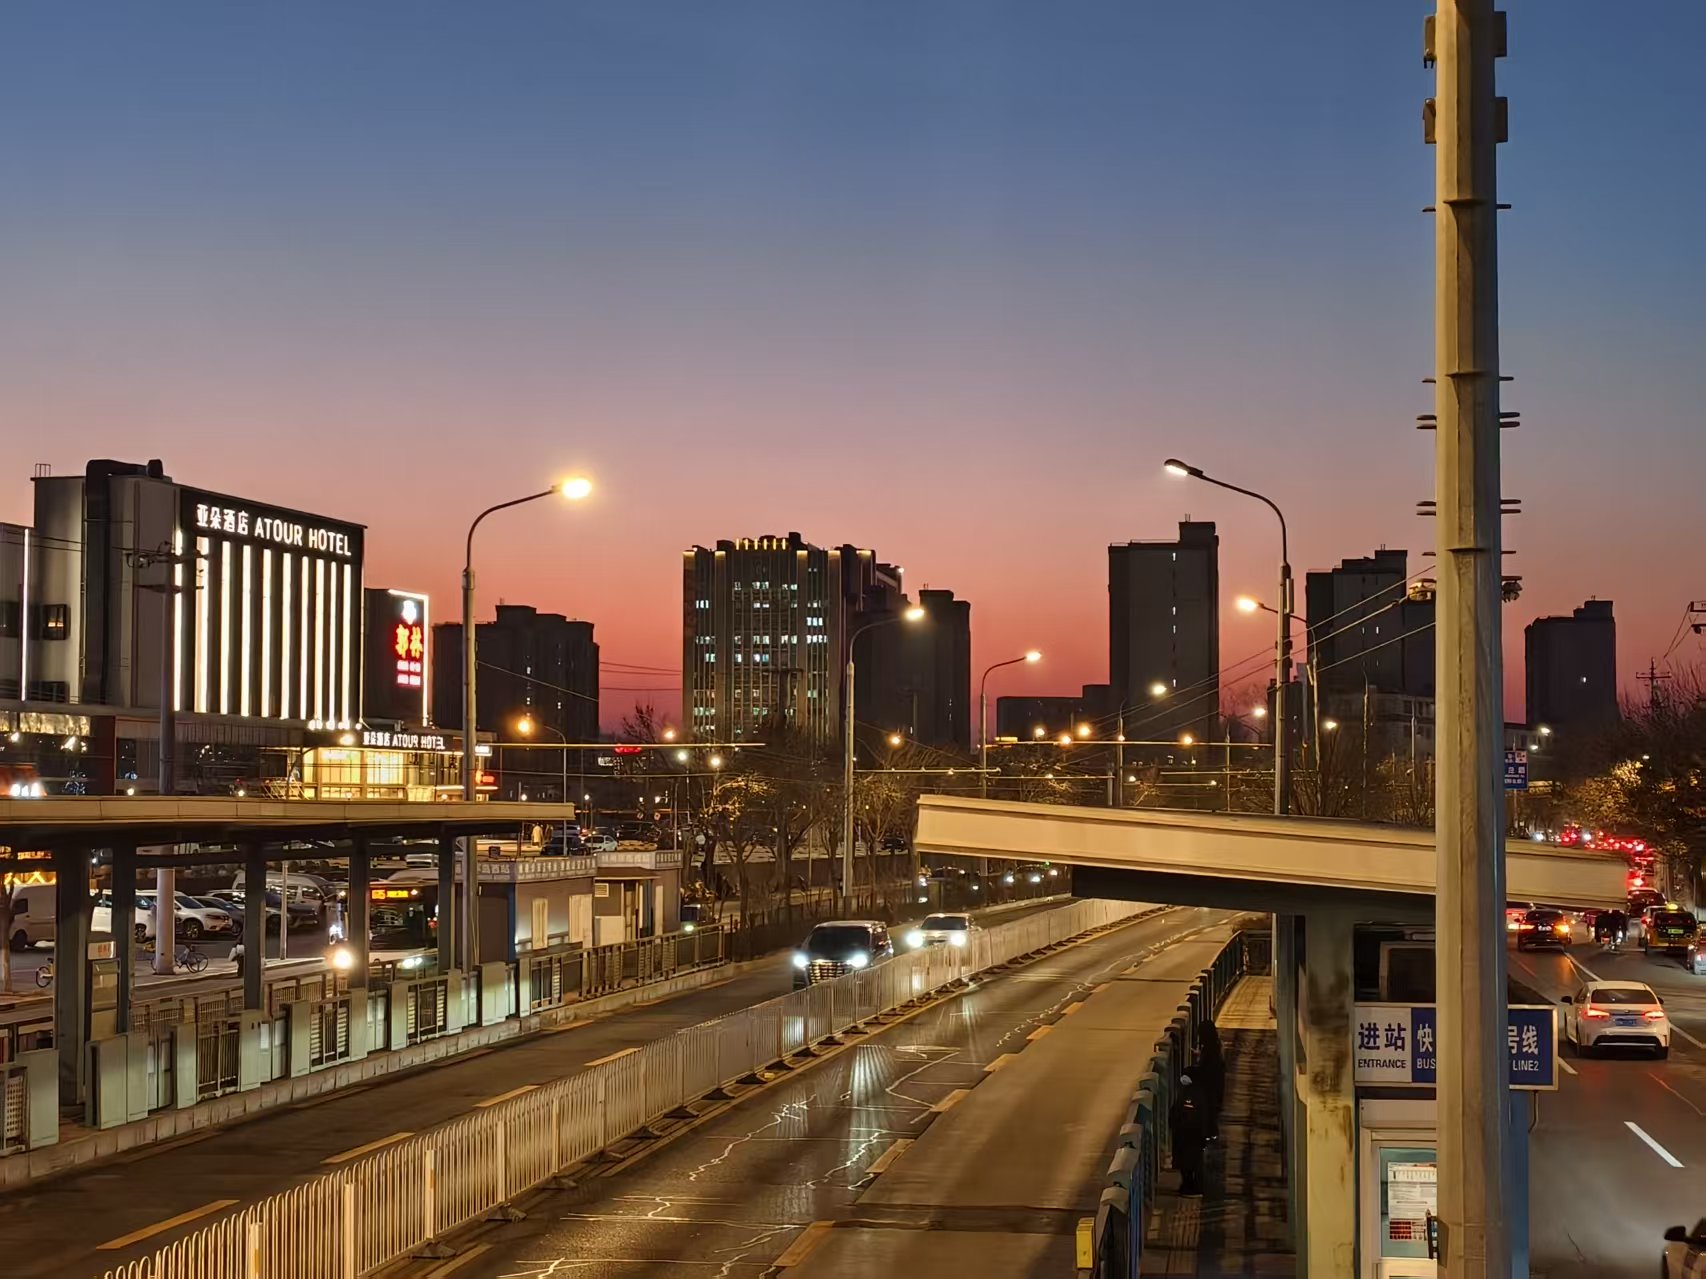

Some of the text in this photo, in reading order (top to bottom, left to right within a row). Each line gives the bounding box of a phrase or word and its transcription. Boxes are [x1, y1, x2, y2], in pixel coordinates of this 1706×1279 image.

[196, 503, 352, 556] 亚朵酒店 ATOUR HOTEL
[392, 733, 419, 748] ATOUR
[420, 735, 446, 750] HOTEL
[1358, 1022, 1407, 1051] 进站
[1357, 1058, 1407, 1069] ENTRANCE
[1416, 1057, 1539, 1071] BUS LINE2
